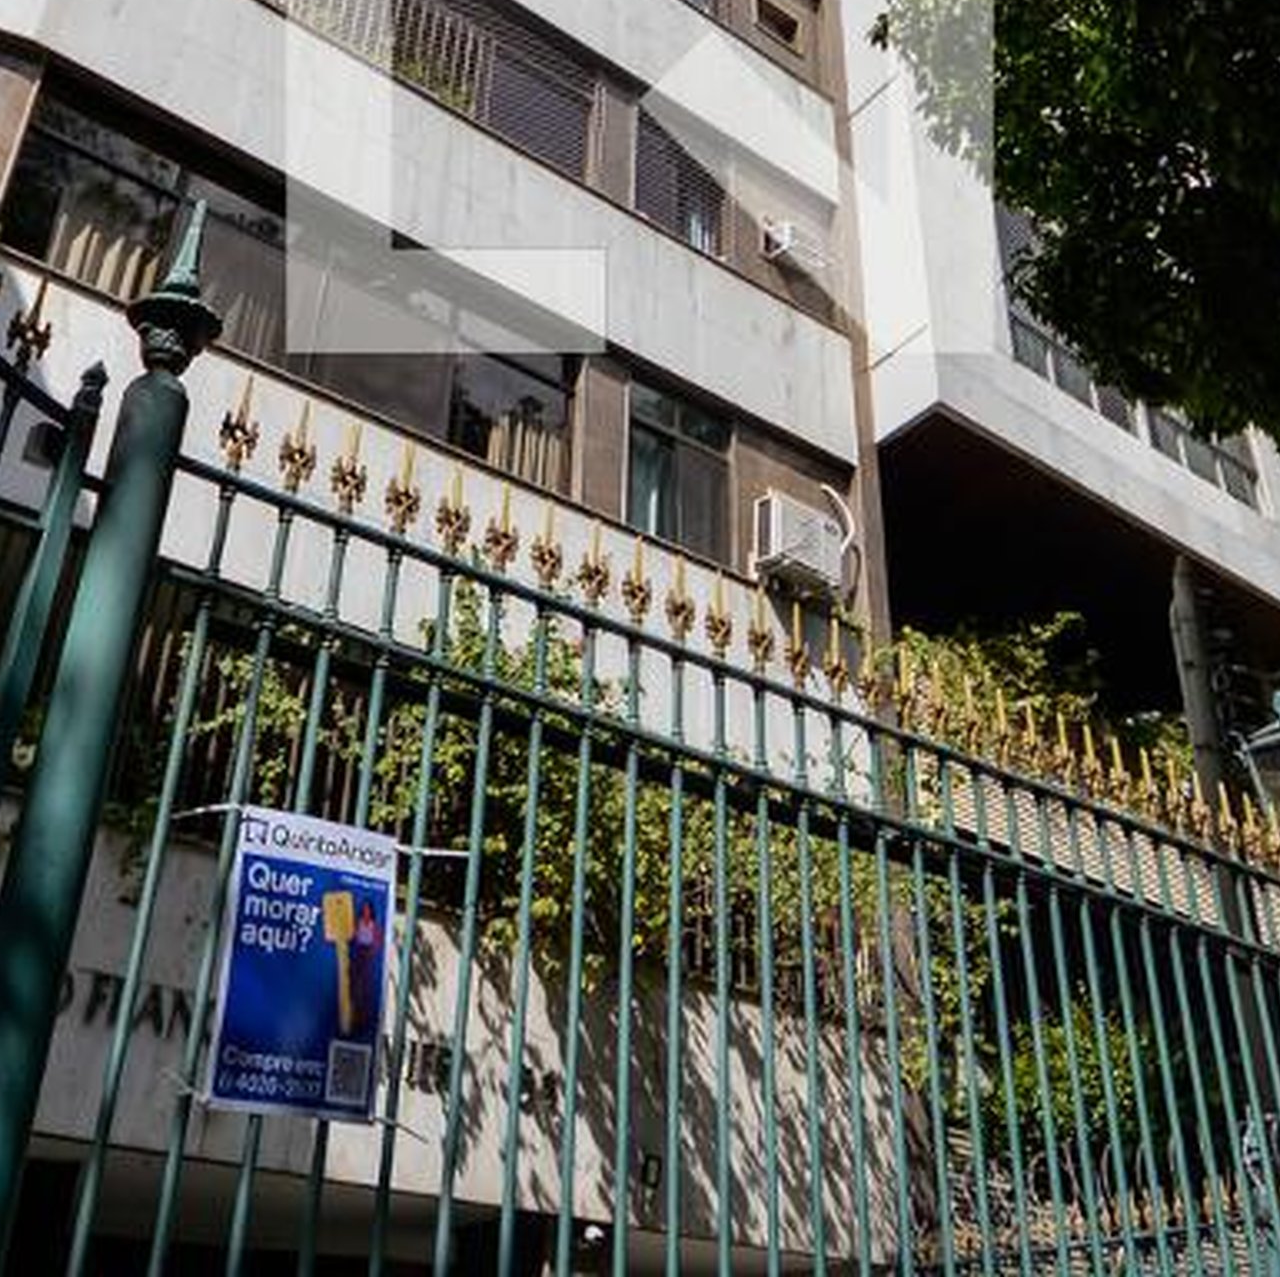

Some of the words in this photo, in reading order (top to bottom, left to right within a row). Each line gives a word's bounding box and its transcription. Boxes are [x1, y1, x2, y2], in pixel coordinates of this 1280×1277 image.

[248, 861, 314, 897] Quer
[243, 893, 322, 926] morar
[240, 923, 313, 953] aqui?
[222, 1045, 294, 1073] Compre
